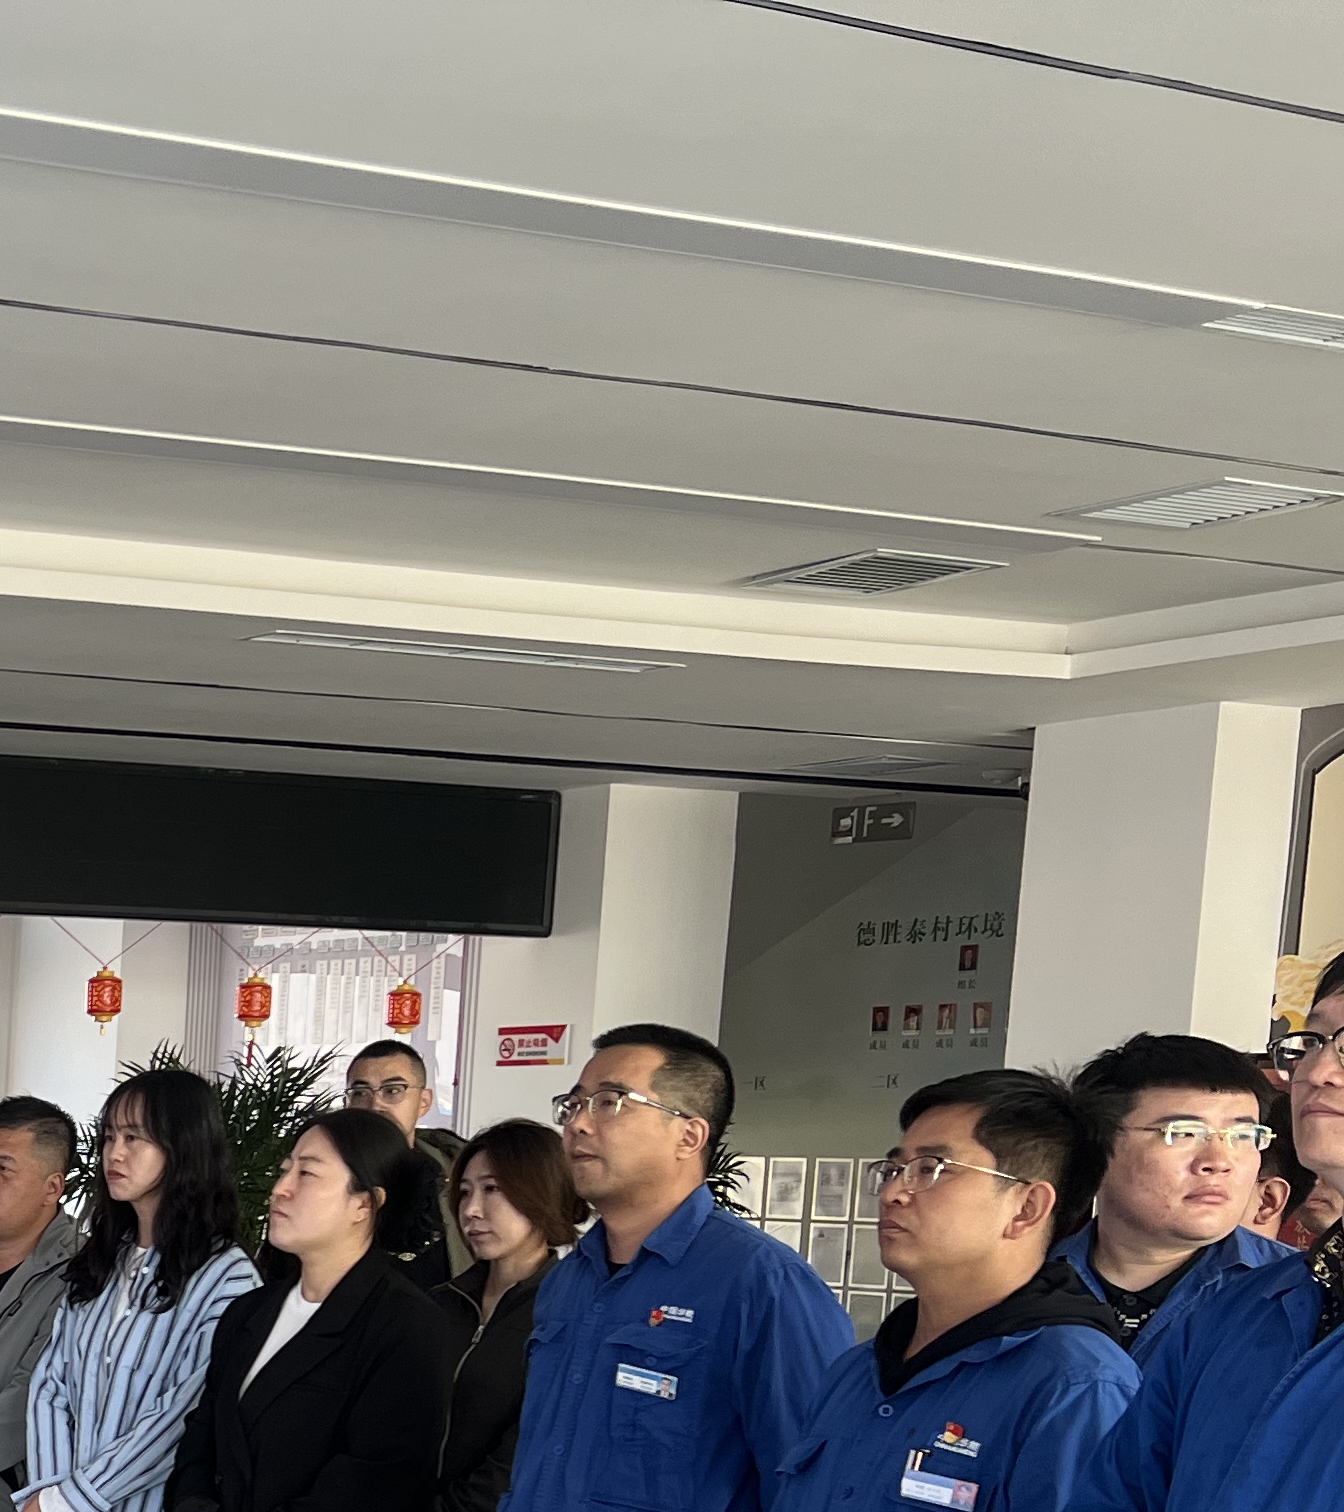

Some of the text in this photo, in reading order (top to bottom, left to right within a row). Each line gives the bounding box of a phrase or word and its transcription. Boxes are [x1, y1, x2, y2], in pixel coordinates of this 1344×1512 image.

[857, 911, 1005, 947] 德胜泰村环境
[871, 1074, 899, 1089] 二区
